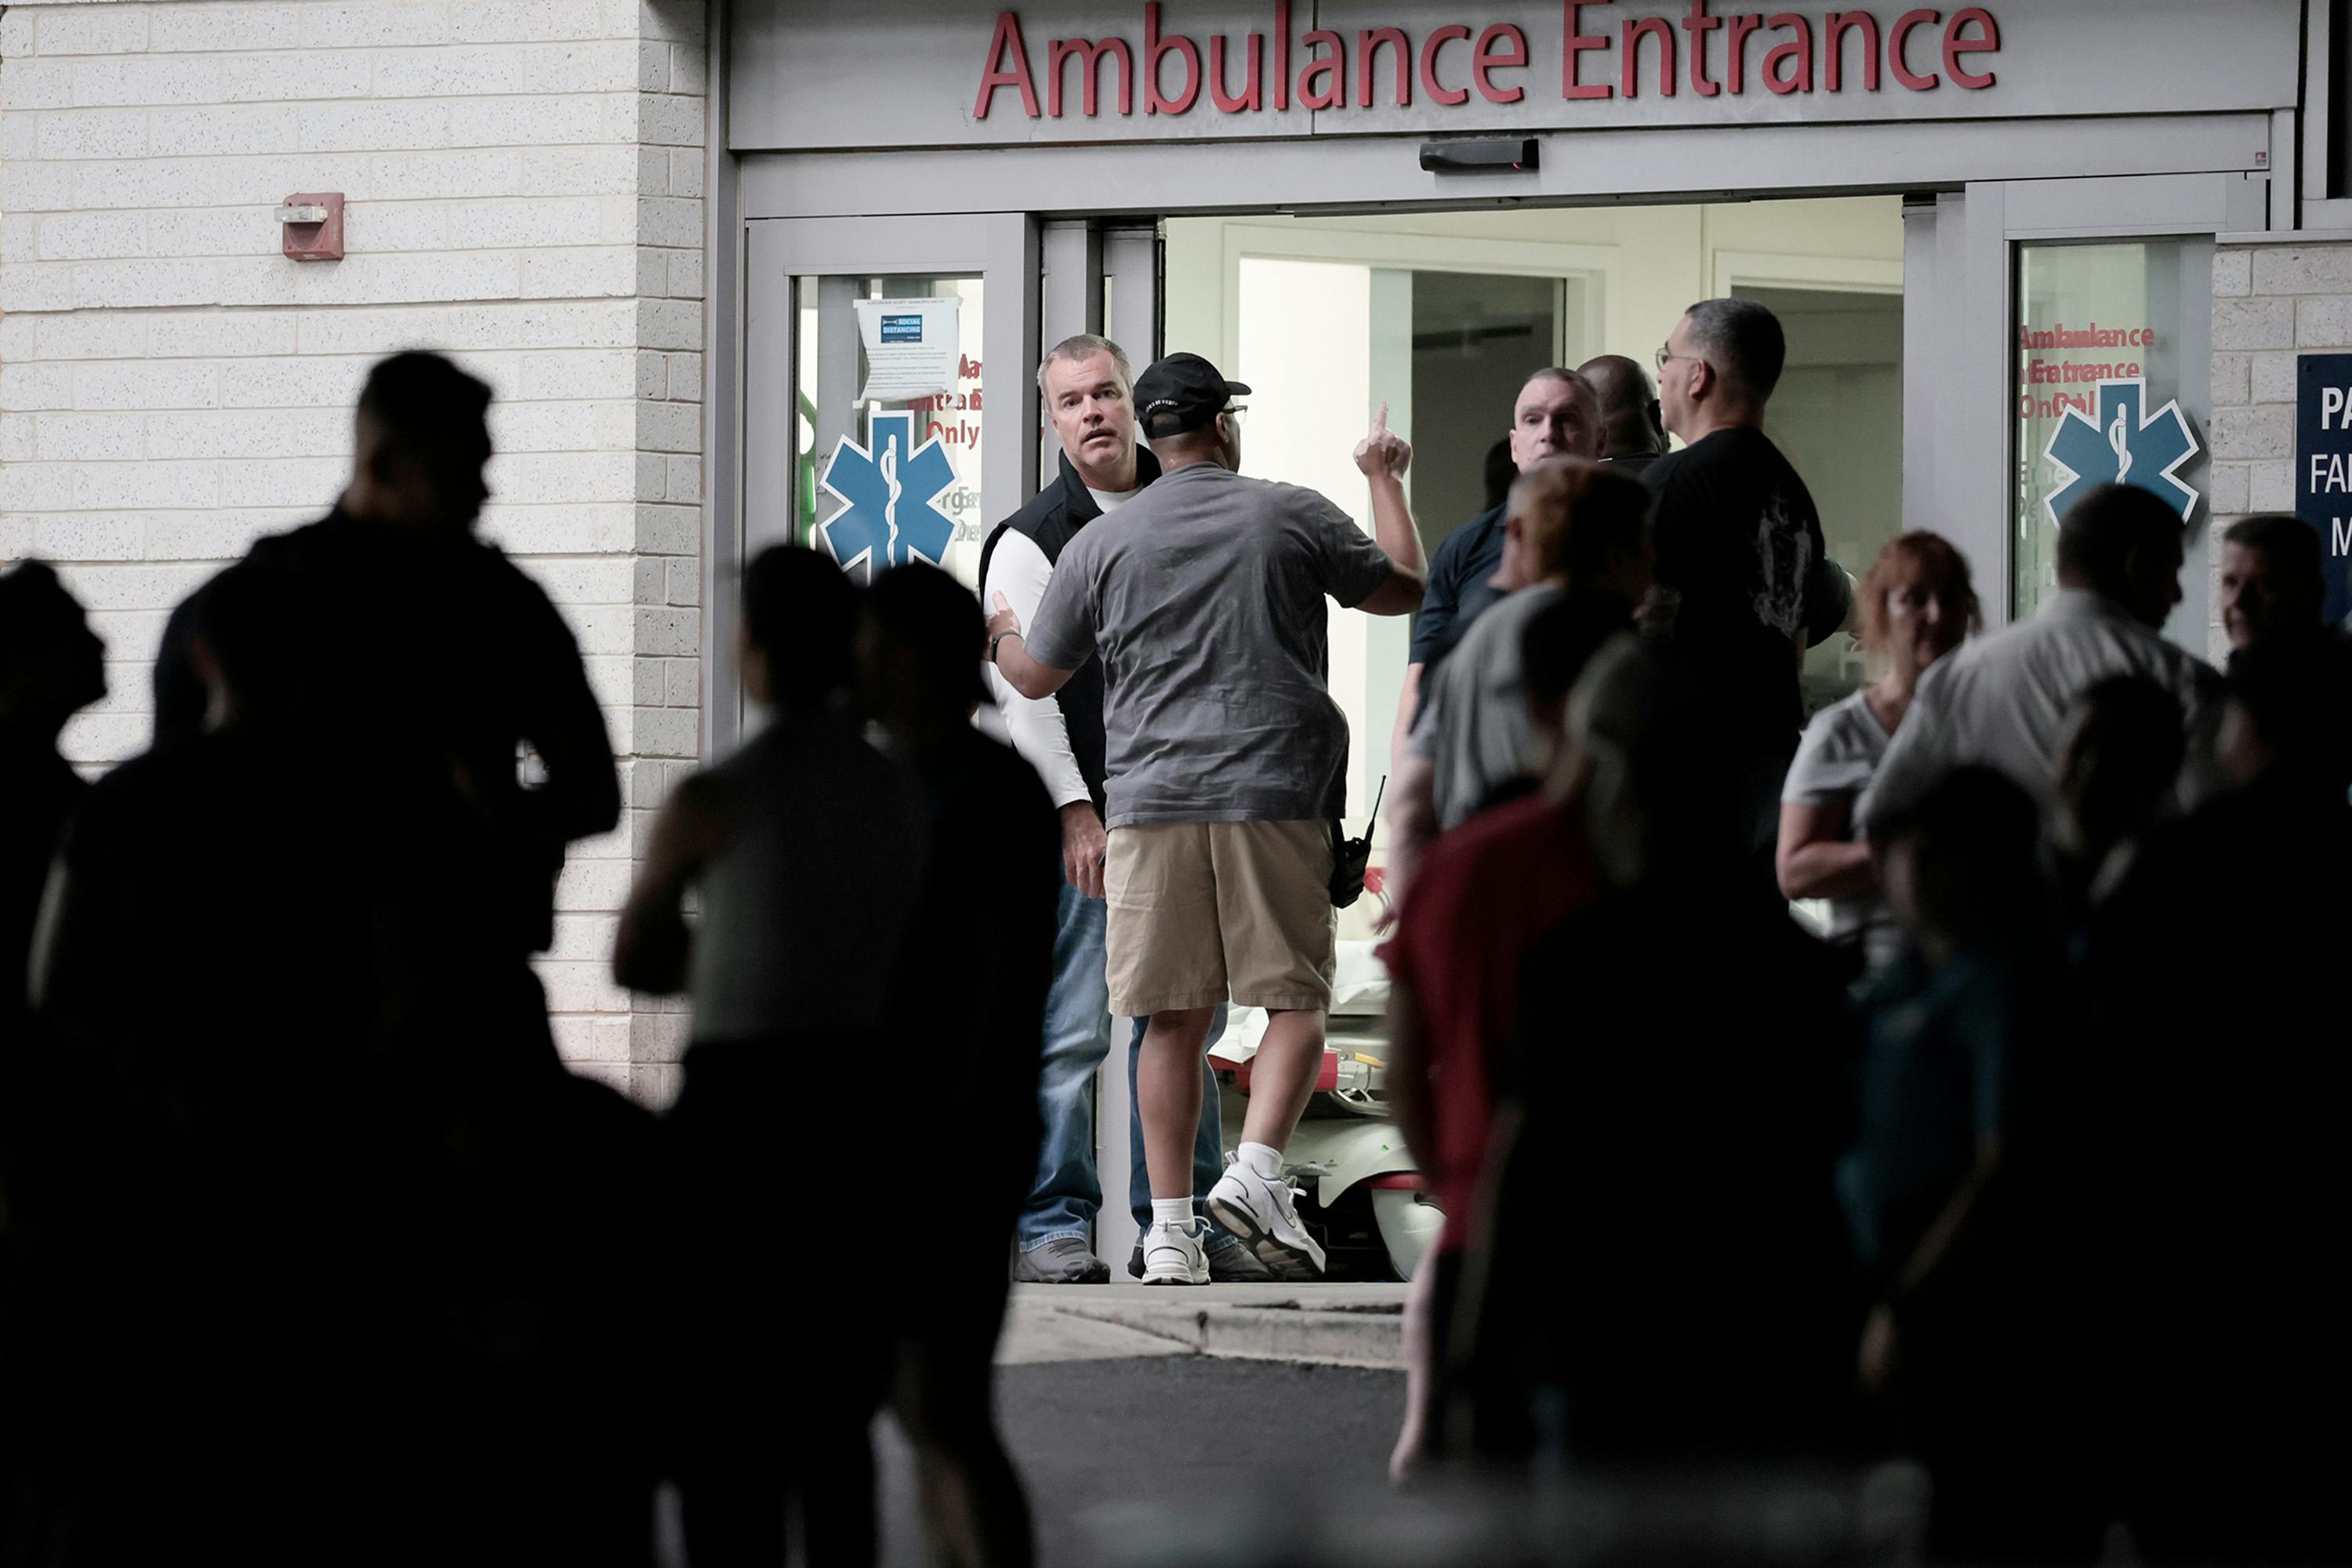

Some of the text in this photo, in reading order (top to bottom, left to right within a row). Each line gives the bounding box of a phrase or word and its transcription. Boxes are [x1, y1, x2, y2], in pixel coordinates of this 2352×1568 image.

[973, 0, 2001, 118] Ambulance Entrance
[2020, 322, 2154, 350] Ambulance
[926, 419, 980, 450] Only
[2310, 453, 2352, 494] FA
